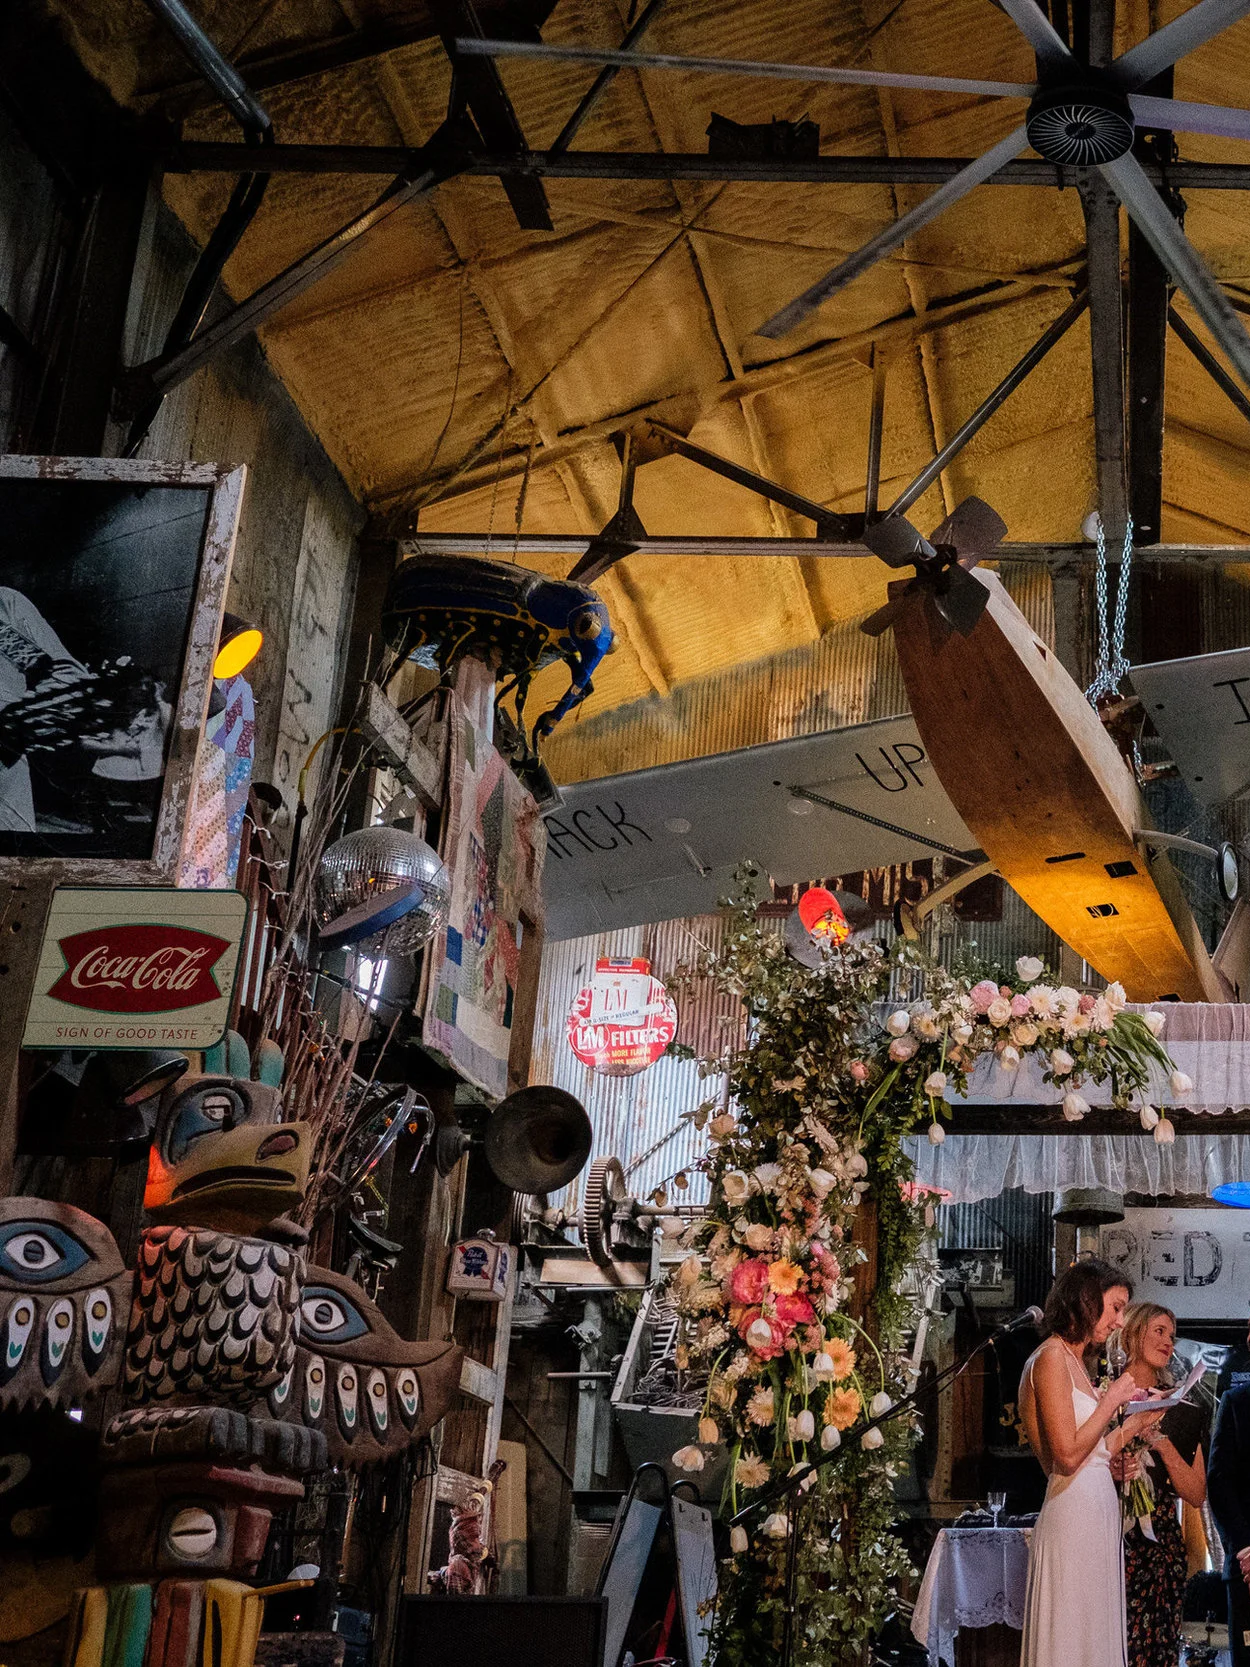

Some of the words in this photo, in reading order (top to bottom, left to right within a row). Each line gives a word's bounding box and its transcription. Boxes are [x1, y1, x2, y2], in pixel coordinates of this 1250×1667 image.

[543, 801, 653, 860] ACK
[855, 743, 926, 792] UP
[70, 945, 212, 991] Coca-Cola
[55, 1026, 89, 1039] SIGN
[93, 1027, 112, 1039] OF
[115, 1027, 157, 1040] GOOD
[161, 1029, 199, 1040] TASTE
[611, 1026, 670, 1047] FILTERS
